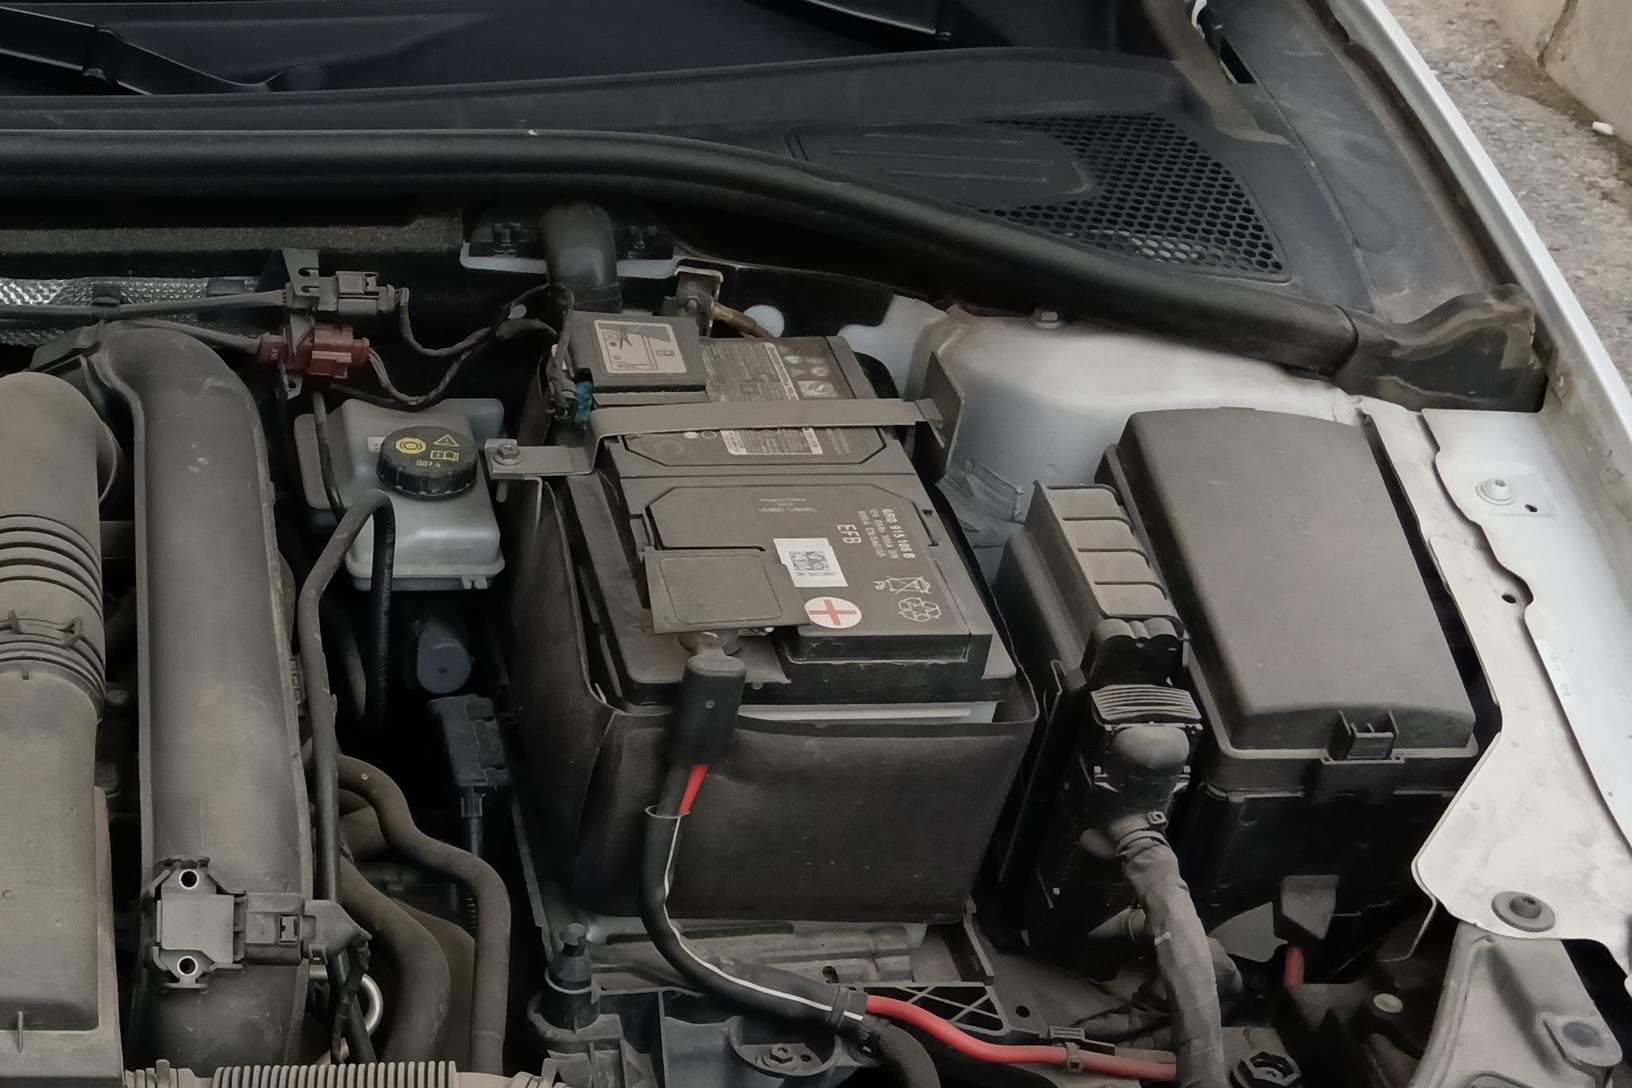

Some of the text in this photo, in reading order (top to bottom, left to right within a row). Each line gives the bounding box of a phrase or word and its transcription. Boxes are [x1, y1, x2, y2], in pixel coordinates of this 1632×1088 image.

[837, 524, 862, 544] EFB
[889, 525, 906, 538] 915
[897, 540, 913, 552] 105
[873, 580, 886, 591] Pb
